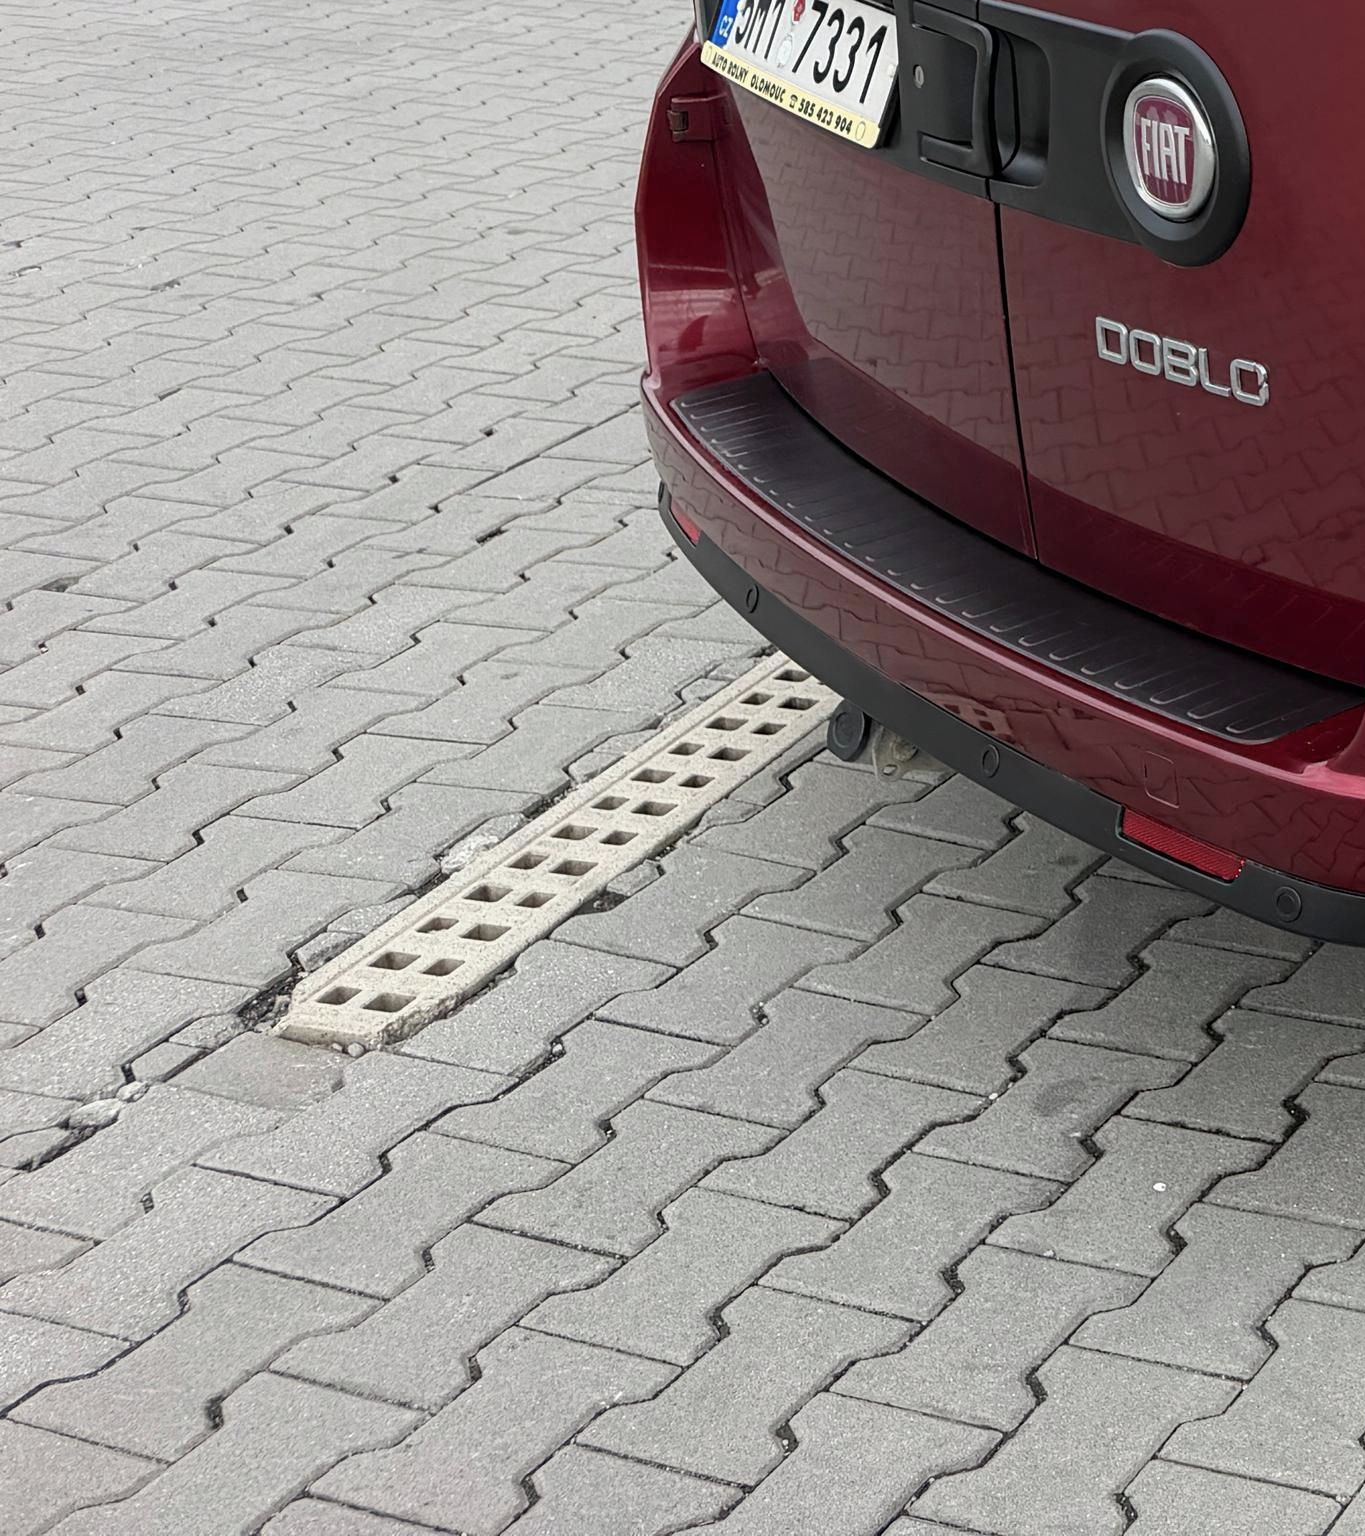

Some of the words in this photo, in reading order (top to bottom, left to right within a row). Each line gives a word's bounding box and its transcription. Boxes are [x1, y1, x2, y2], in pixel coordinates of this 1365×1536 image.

[719, 15, 734, 38] CZ
[712, 51, 728, 72] AUTO
[750, 74, 787, 104] OLOMOUC
[798, 97, 815, 118] 585
[816, 105, 834, 126] 423
[834, 114, 853, 136] 904
[1140, 117, 1190, 185] FIAT
